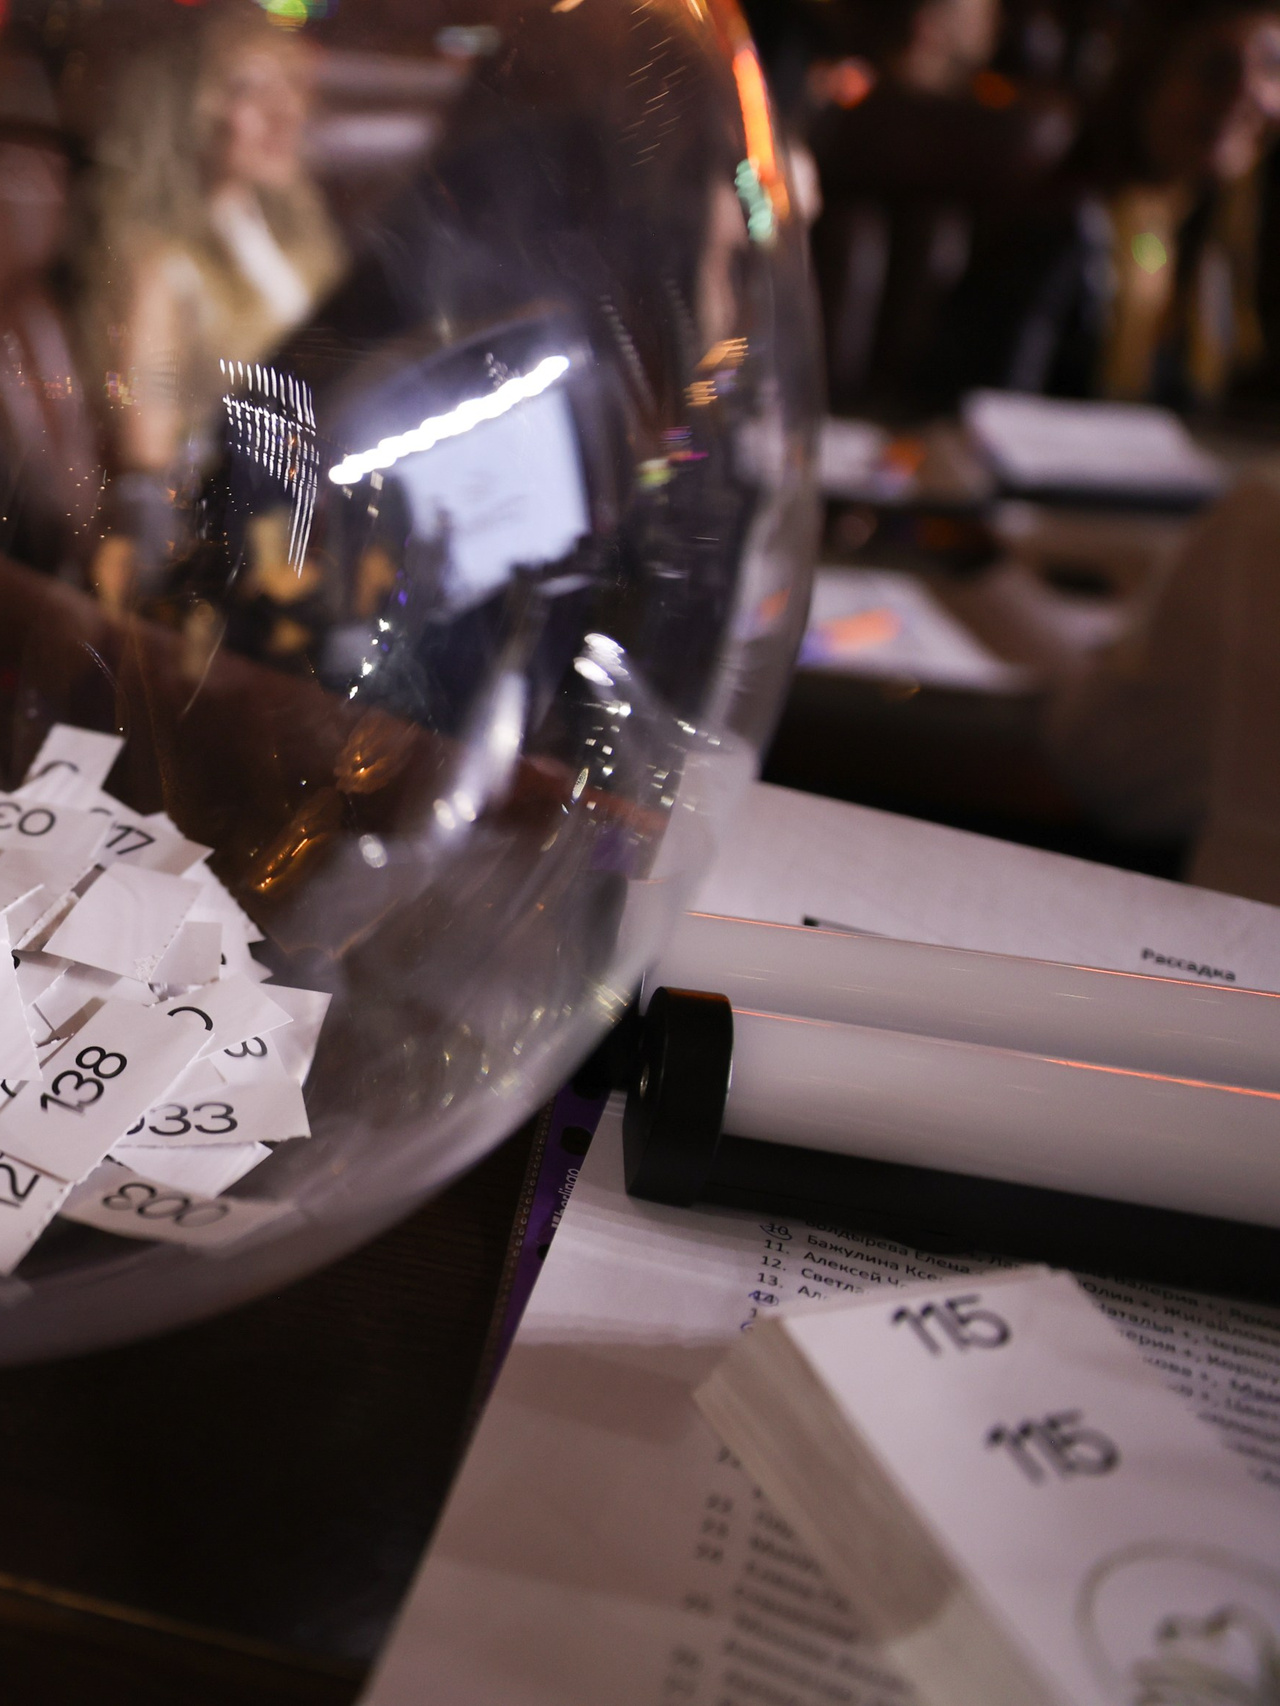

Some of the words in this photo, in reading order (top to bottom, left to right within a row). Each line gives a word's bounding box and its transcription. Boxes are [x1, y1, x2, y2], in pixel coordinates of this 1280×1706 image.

[1141, 947, 1237, 983] Рассадка
[40, 1045, 128, 1117] 138
[126, 1101, 239, 1137] 33
[102, 1182, 229, 1228] 003
[756, 1272, 783, 1289] 13.
[760, 1255, 787, 1272] 12.
[763, 1239, 790, 1254] 11.
[803, 1251, 882, 1284] Алексей
[807, 1234, 900, 1272] Бажулина
[904, 1264, 944, 1283] Ксе
[892, 1295, 1011, 1357] 115
[986, 1410, 1120, 1486] 115
